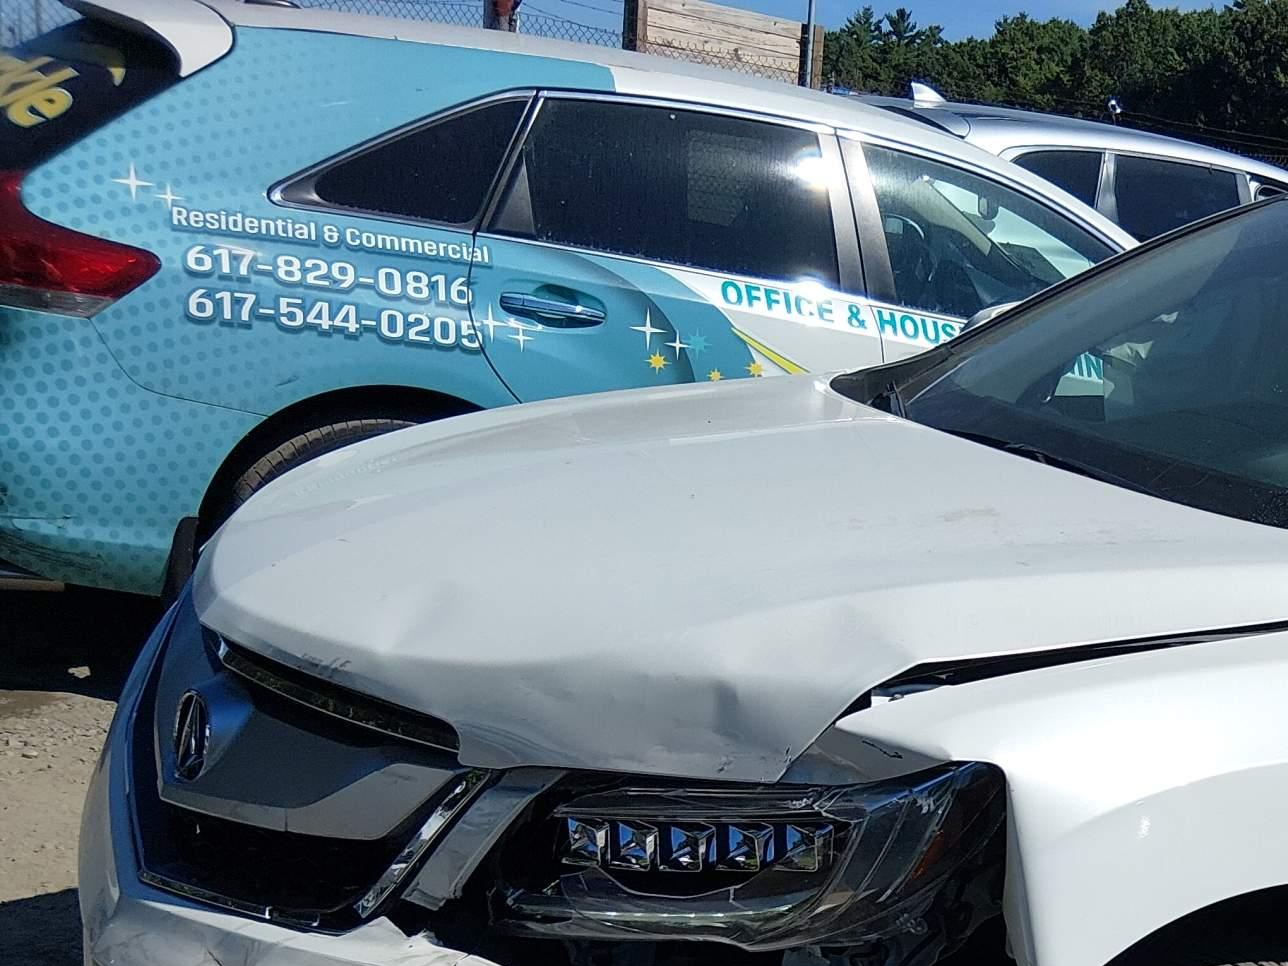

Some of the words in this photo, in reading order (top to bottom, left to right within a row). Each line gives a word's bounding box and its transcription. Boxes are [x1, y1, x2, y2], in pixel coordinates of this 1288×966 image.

[172, 207, 316, 240] Residential
[323, 225, 340, 244] &
[345, 227, 490, 264] Commercial
[186, 246, 473, 305] 617-829-0816
[187, 288, 483, 348] 617-544-0205
[721, 280, 834, 323] OFFICE
[848, 304, 867, 330] &
[877, 309, 960, 344] HOUS
